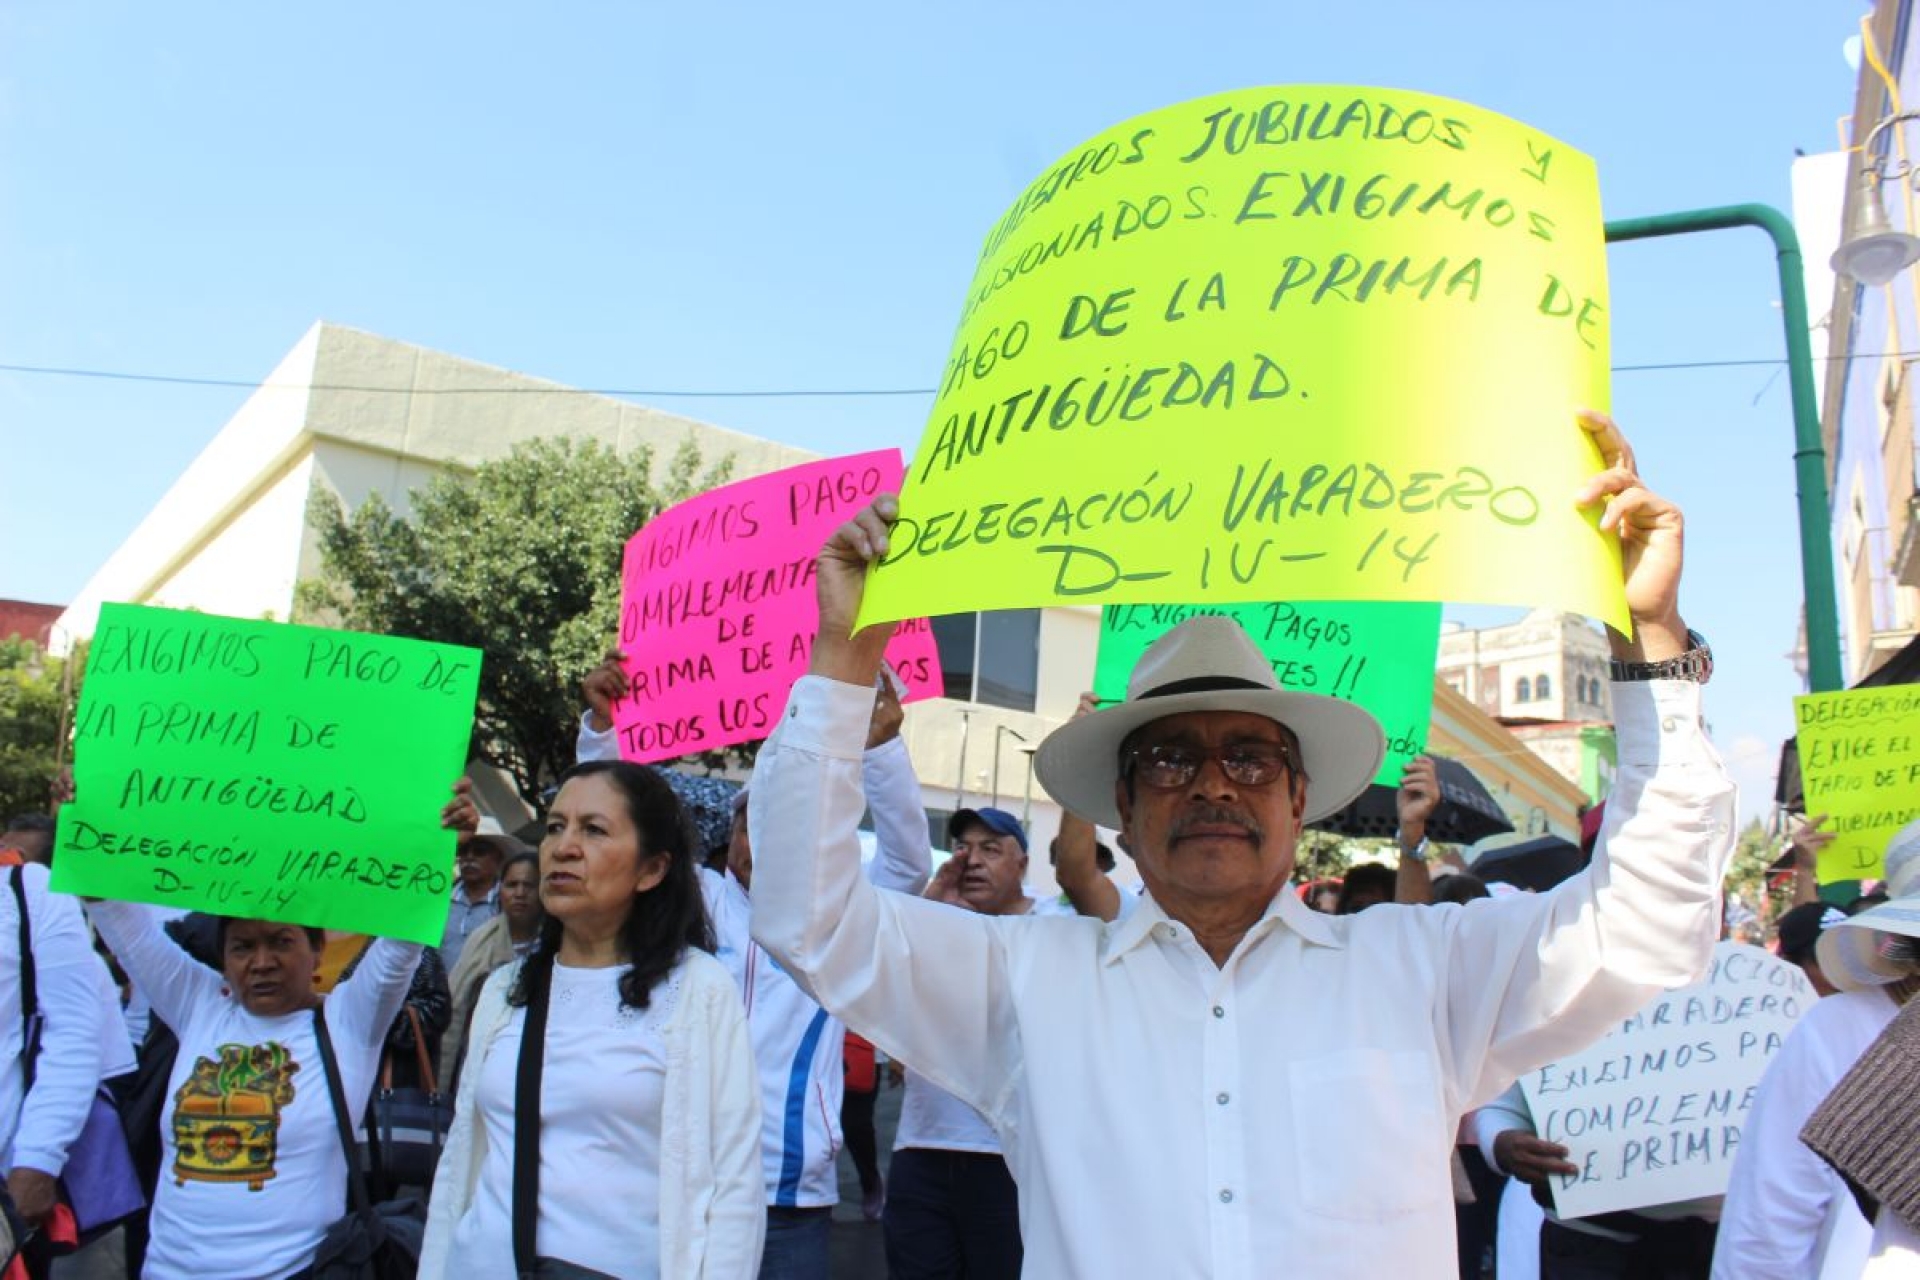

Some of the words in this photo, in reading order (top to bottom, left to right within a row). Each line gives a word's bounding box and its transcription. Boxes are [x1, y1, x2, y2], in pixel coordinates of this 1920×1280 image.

[1180, 99, 1470, 164] JUBILADOS
[1521, 140, 1553, 184] Y
[1234, 172, 1557, 243] EXIGIMOS
[942, 320, 1030, 400] AGO
[1059, 288, 1136, 341] DE
[1164, 272, 1227, 322] LA
[1269, 253, 1484, 313] PRIMA
[1538, 274, 1602, 350] DE
[921, 353, 1309, 484] ANTIGÜEDAD.
[788, 467, 882, 526] PAGO
[875, 471, 1193, 572] DELEGACIÓN
[1222, 458, 1540, 533] VARADERO
[717, 613, 756, 643] DE
[1262, 602, 1352, 650] PAGOS
[90, 624, 269, 678] EXIGIMOS
[303, 641, 401, 684] PAGO
[416, 650, 471, 695] DE
[740, 646, 773, 674] DE
[75, 700, 116, 742] LA
[133, 700, 261, 755] PRIMA
[286, 714, 340, 749] DE
[621, 714, 706, 754] TODOS
[719, 692, 770, 731] LOS
[1807, 736, 1876, 771] EXIGE
[1887, 736, 1910, 752] EL
[118, 768, 368, 824] ANTIGÜEDAD
[1808, 776, 1862, 797] TARIO
[1874, 769, 1895, 787] DE
[63, 820, 258, 868] DELEGACIÓN
[277, 850, 447, 896] VARADERO
[1607, 994, 1800, 1036] ARADERO
[1739, 1031, 1782, 1058] PA
[1546, 1086, 1757, 1144] COMPLEME
[1616, 1125, 1742, 1180] PRIMA
